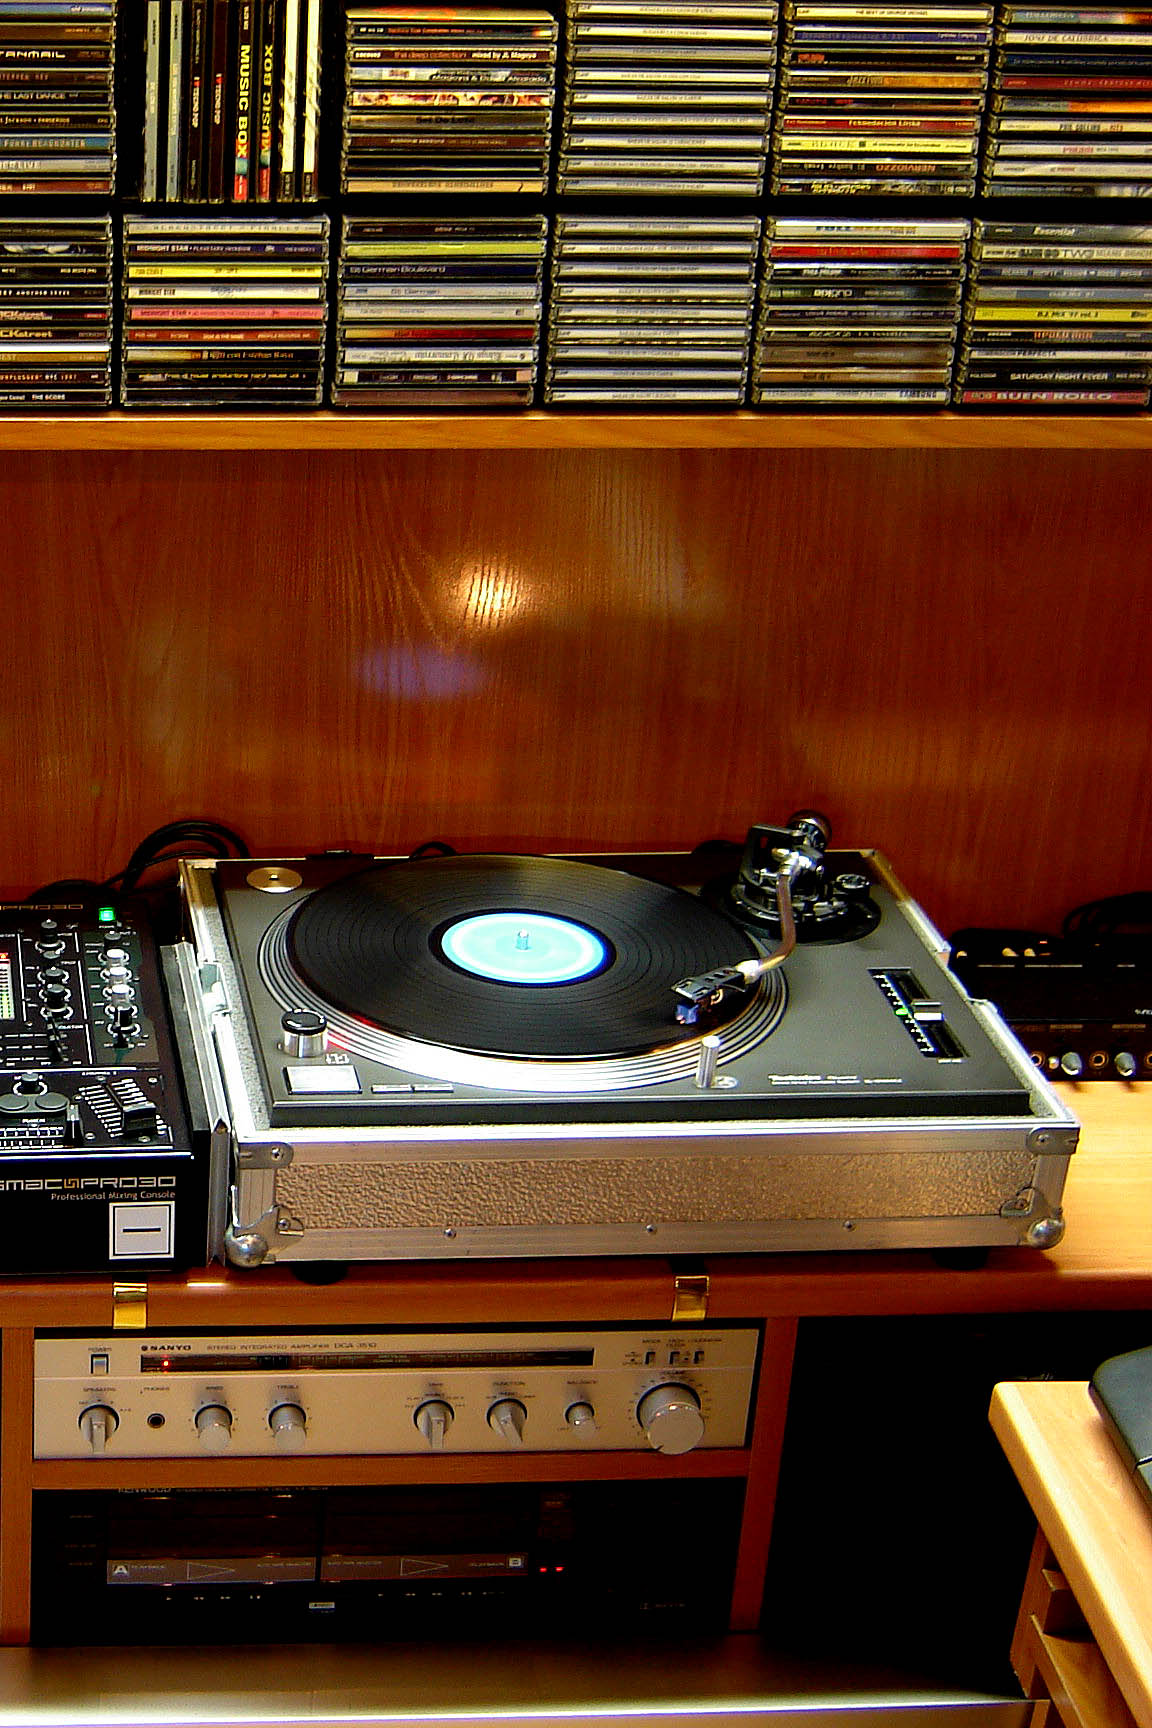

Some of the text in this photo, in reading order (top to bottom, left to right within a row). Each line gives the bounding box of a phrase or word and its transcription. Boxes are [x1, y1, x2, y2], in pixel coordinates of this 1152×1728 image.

[13, 92, 34, 100] LAST
[237, 44, 250, 158] MUSIC BOX
[260, 44, 273, 154] MUSIC BOX
[996, 392, 1112, 400] BUEN ROLLO
[50, 1190, 176, 1200] Professional Mixing Console
[112, 1563, 129, 1575] A
